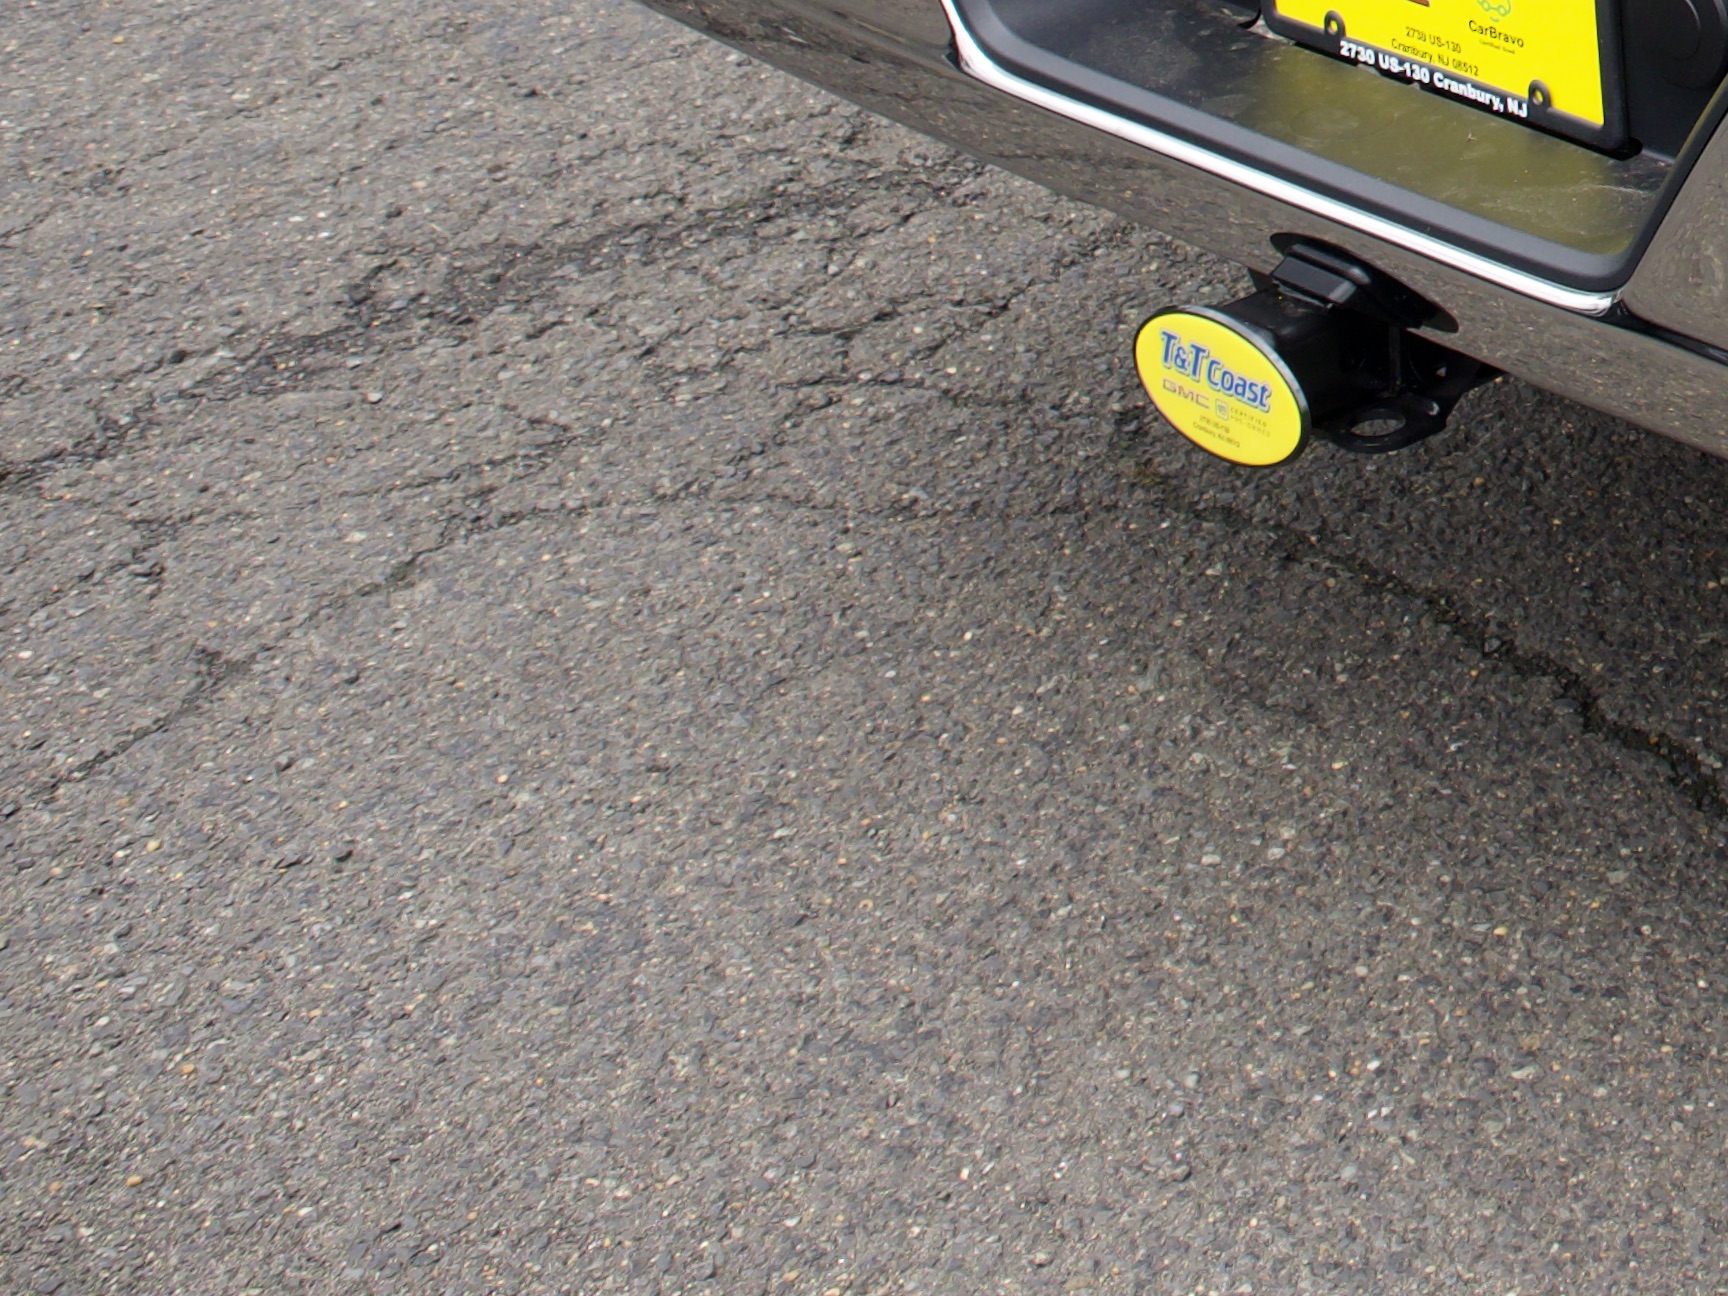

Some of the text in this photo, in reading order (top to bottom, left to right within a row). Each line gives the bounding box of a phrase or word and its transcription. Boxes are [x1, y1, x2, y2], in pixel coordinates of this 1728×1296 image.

[1429, 34, 1462, 54] US-130
[1468, 19, 1525, 48] CarBravo
[1438, 54, 1450, 66] NJ
[1340, 40, 1528, 118] 2730 US-130 Cranbury, NJ
[1160, 329, 1272, 414] T&T Coast
[1163, 378, 1210, 409] GMC
